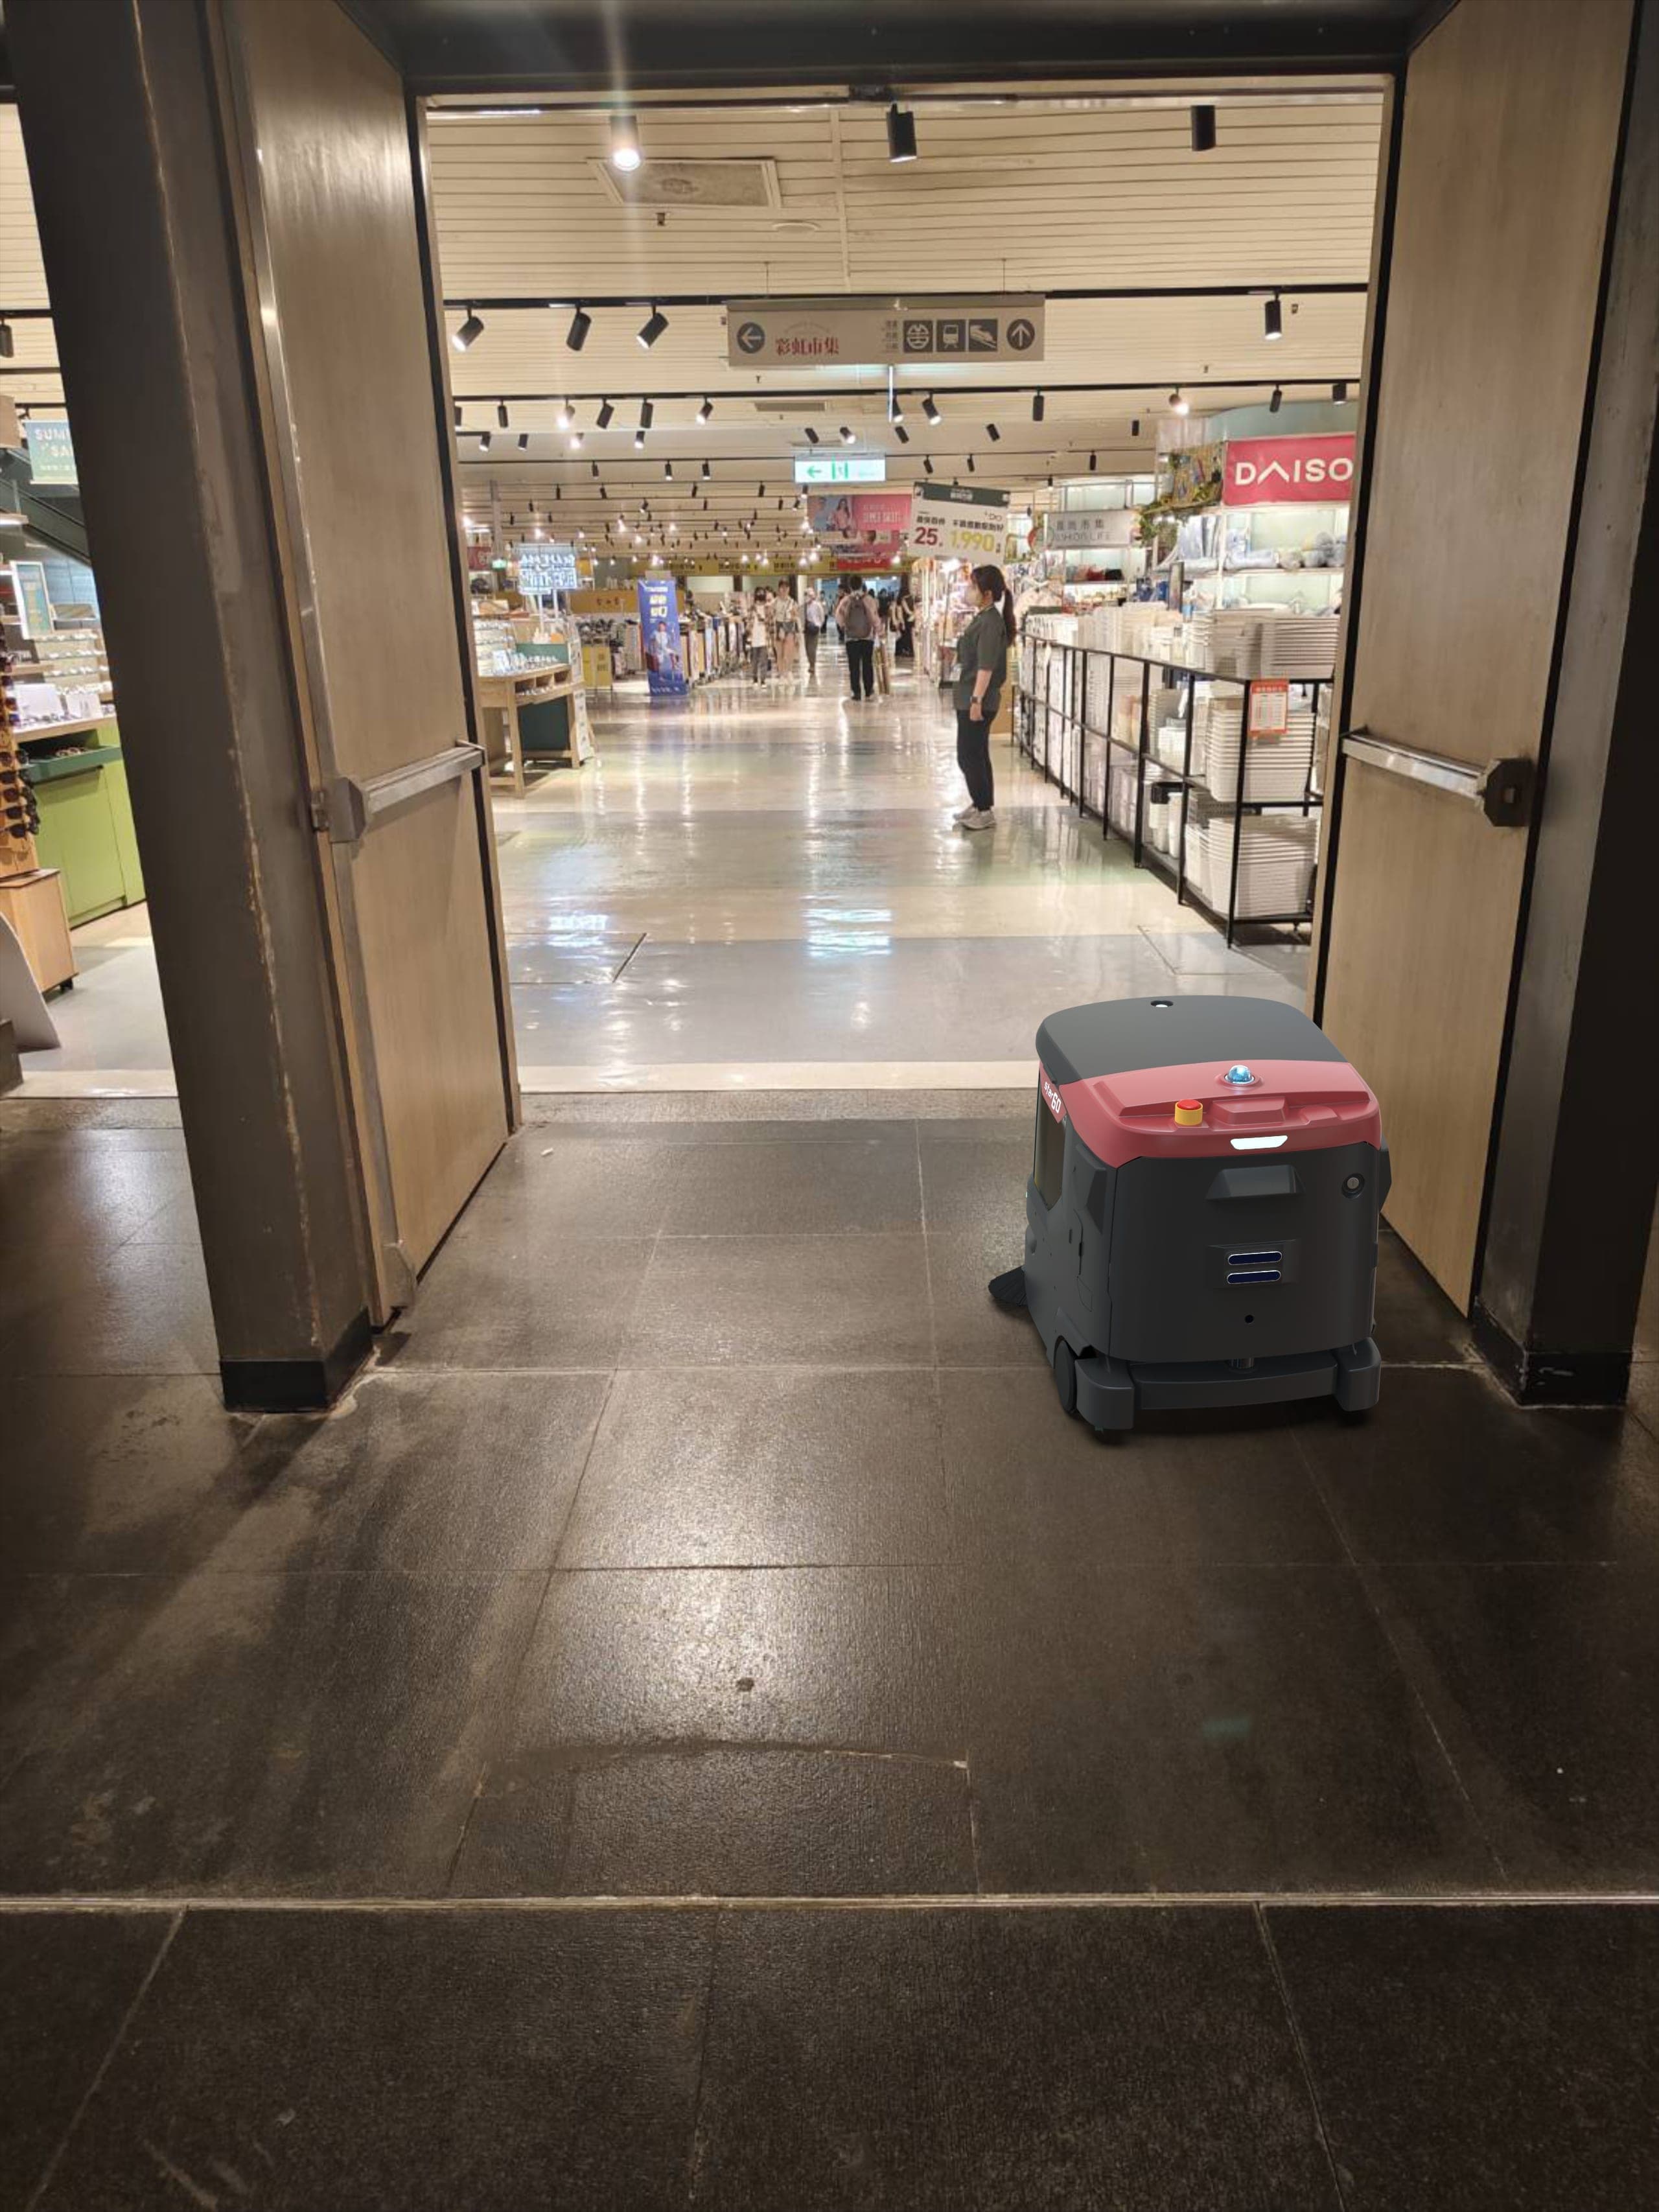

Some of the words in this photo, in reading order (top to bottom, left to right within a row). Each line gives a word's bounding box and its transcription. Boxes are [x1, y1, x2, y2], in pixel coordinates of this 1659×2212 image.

[776, 337, 839, 355] 彩虹市集
[1235, 458, 1353, 485] DAISO
[914, 527, 938, 546] 25
